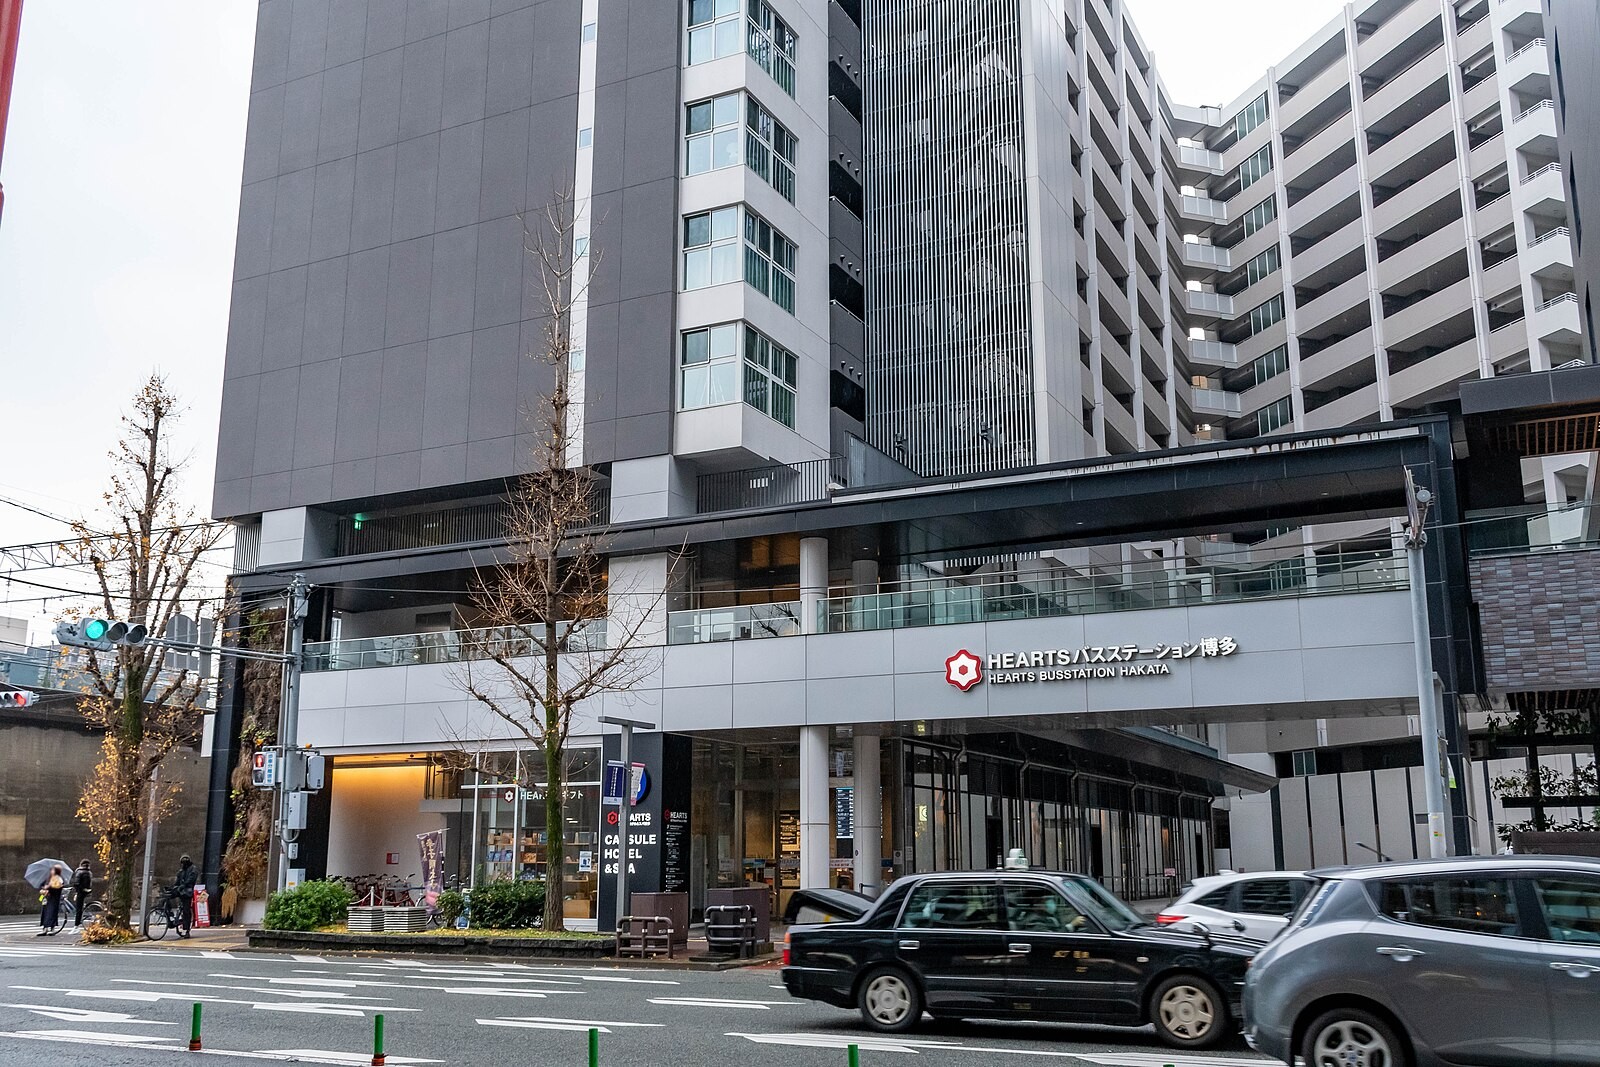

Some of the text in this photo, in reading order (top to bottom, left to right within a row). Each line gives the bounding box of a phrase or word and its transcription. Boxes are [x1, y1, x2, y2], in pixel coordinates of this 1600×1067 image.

[989, 663, 1169, 683] HEARTS BUSSTATION HAKATA
[618, 813, 651, 822] ARTS
[670, 811, 688, 820] HEARTS
[604, 834, 657, 845] CASULE
[604, 849, 642, 859] HOEL
[604, 863, 635, 874] &SA
